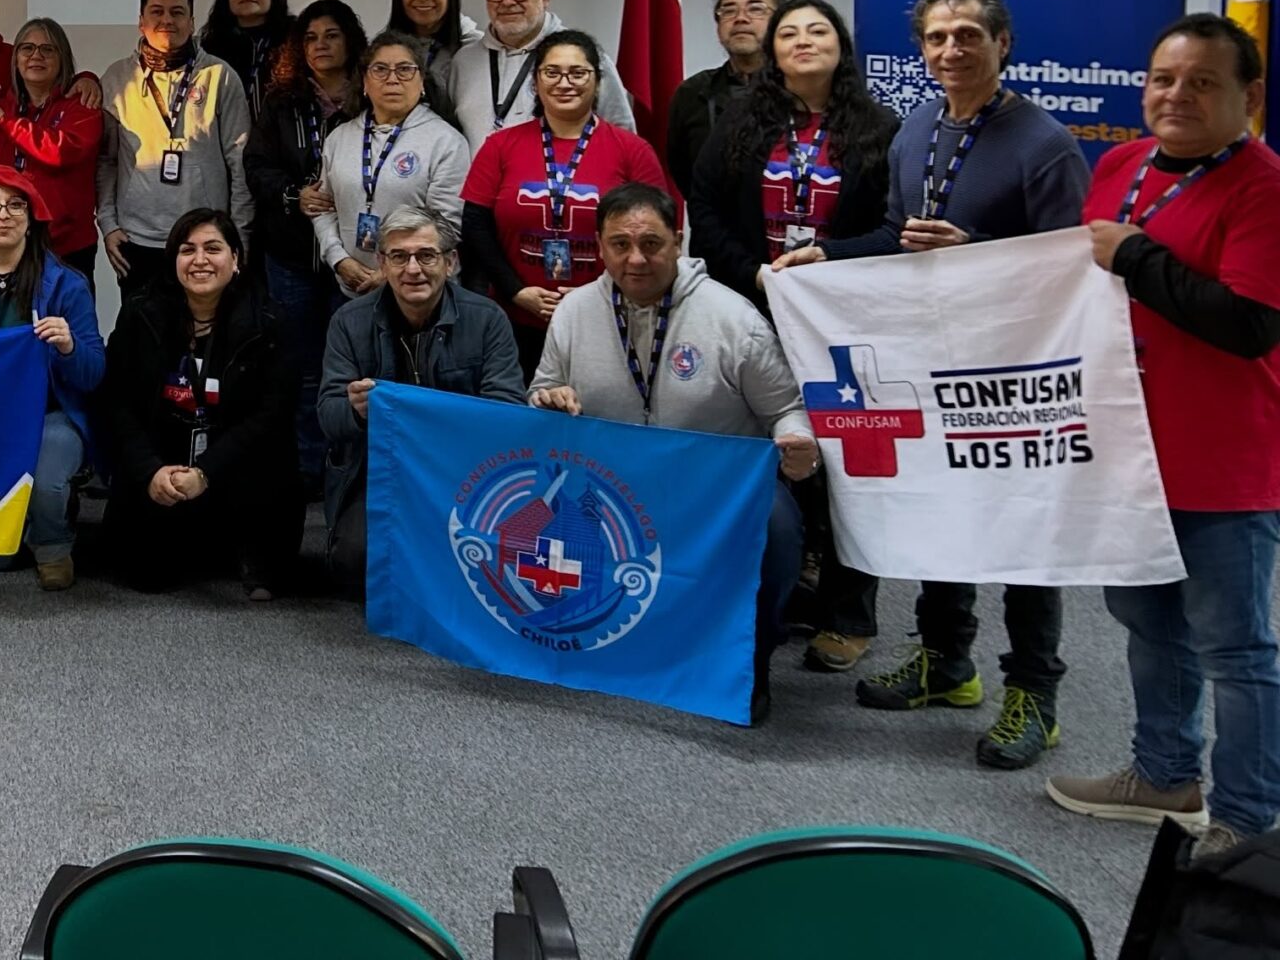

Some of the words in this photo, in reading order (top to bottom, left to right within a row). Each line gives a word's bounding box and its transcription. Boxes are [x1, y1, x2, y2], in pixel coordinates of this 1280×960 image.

[1000, 59, 1148, 87] ntribuimo
[933, 369, 1083, 409] CONFUSAM
[825, 415, 902, 430] CONFUSAM
[941, 406, 1031, 428] FEDERACIÓN
[945, 441, 1011, 470] LOS
[1024, 430, 1094, 469] RÍOS
[455, 447, 535, 505] CONFUSAM
[520, 626, 583, 653] CHILOÉ
